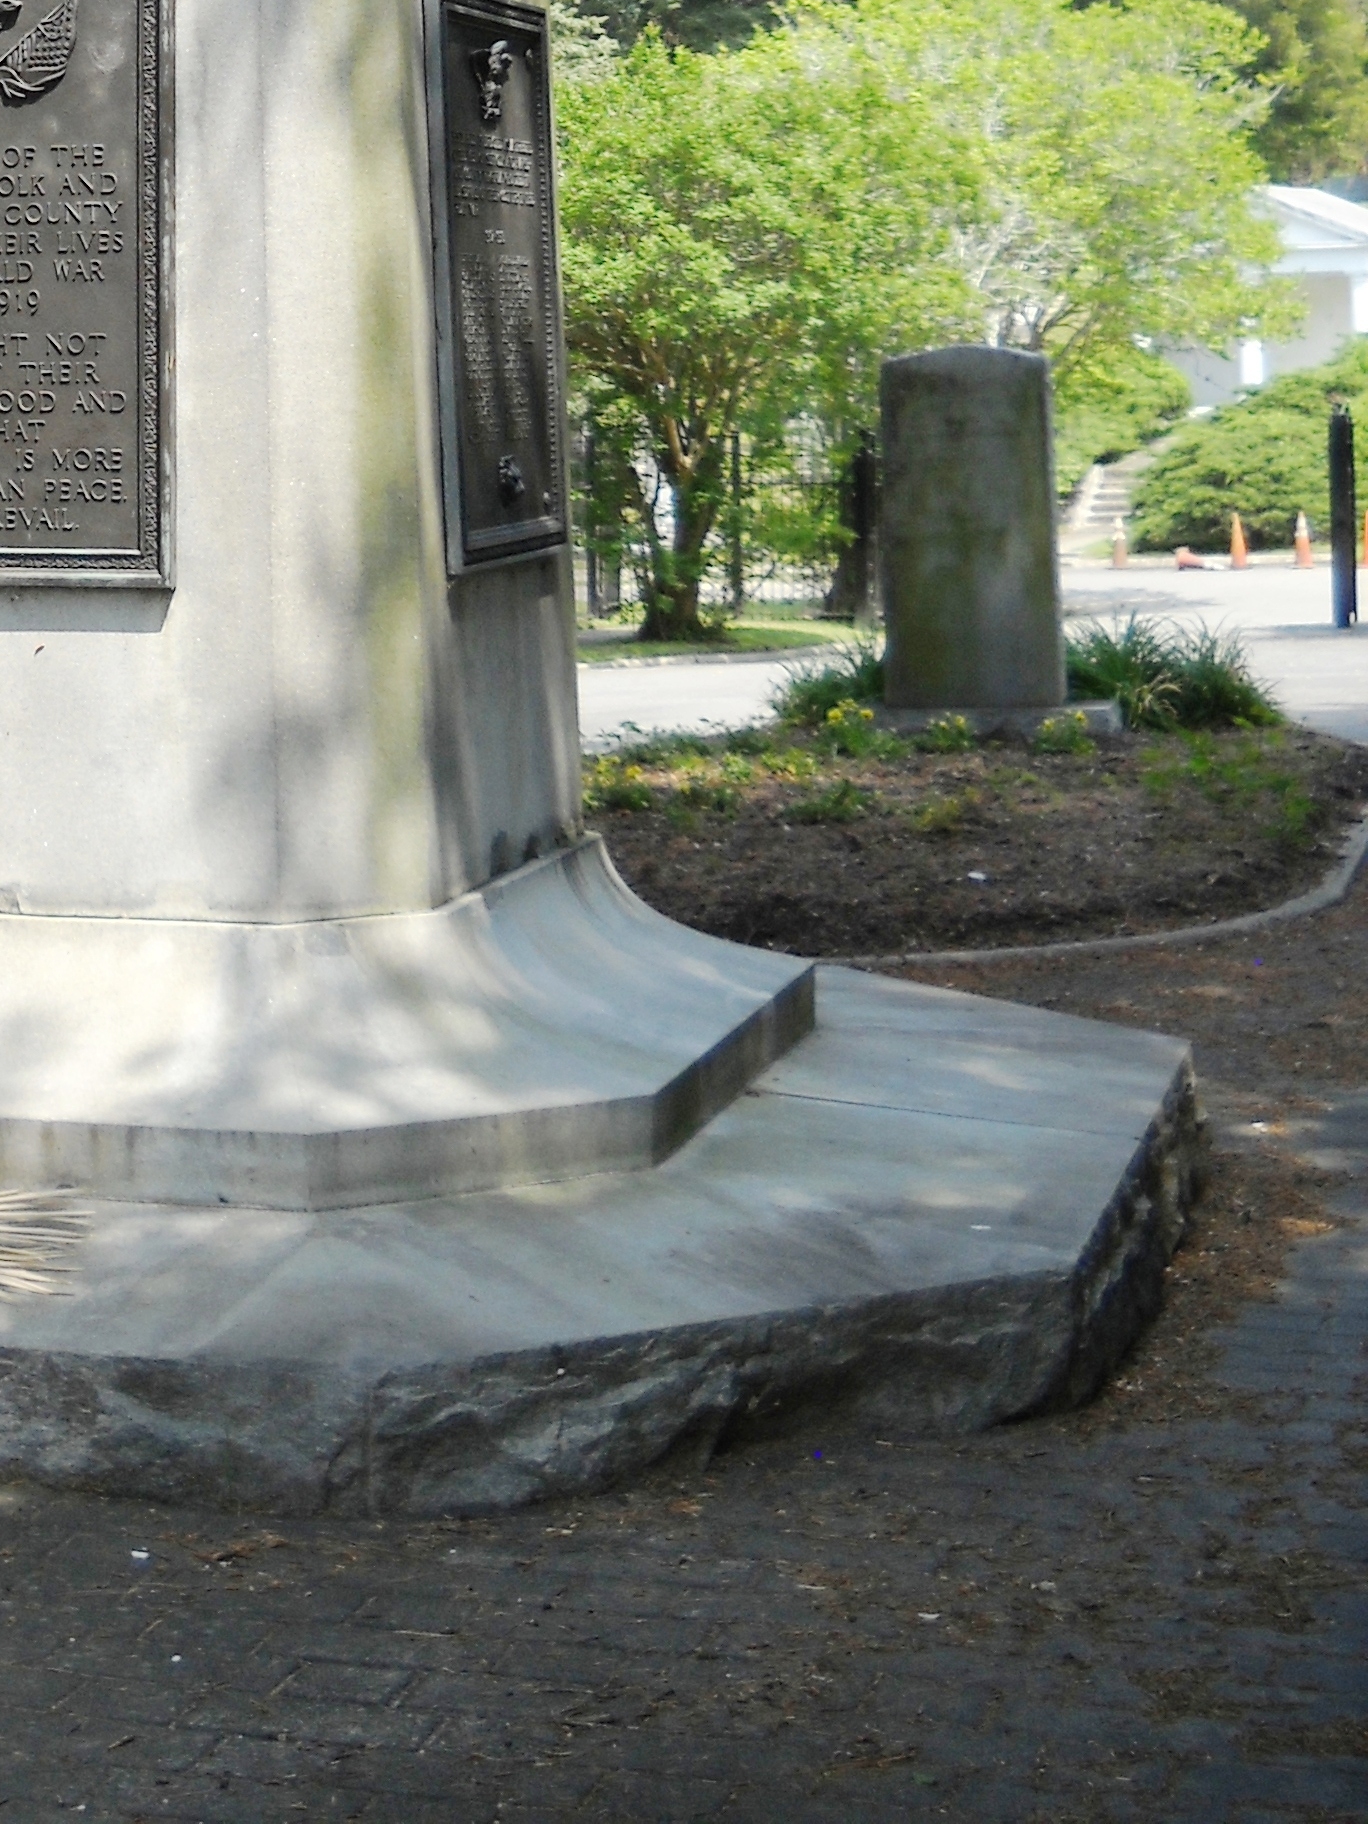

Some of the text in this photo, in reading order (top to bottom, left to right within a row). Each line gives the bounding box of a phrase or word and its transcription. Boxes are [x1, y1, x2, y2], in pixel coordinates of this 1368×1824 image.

[2, 145, 36, 169] OF
[50, 144, 105, 168] THE
[59, 172, 118, 196] AND
[4, 200, 123, 225] COUNTY
[56, 230, 124, 254] LIVES
[53, 258, 105, 282] WAR
[45, 331, 108, 357] NOT
[18, 360, 100, 385] THEIR
[71, 389, 127, 414] AND
[15, 448, 34, 471] IS
[52, 447, 123, 471] MORE
